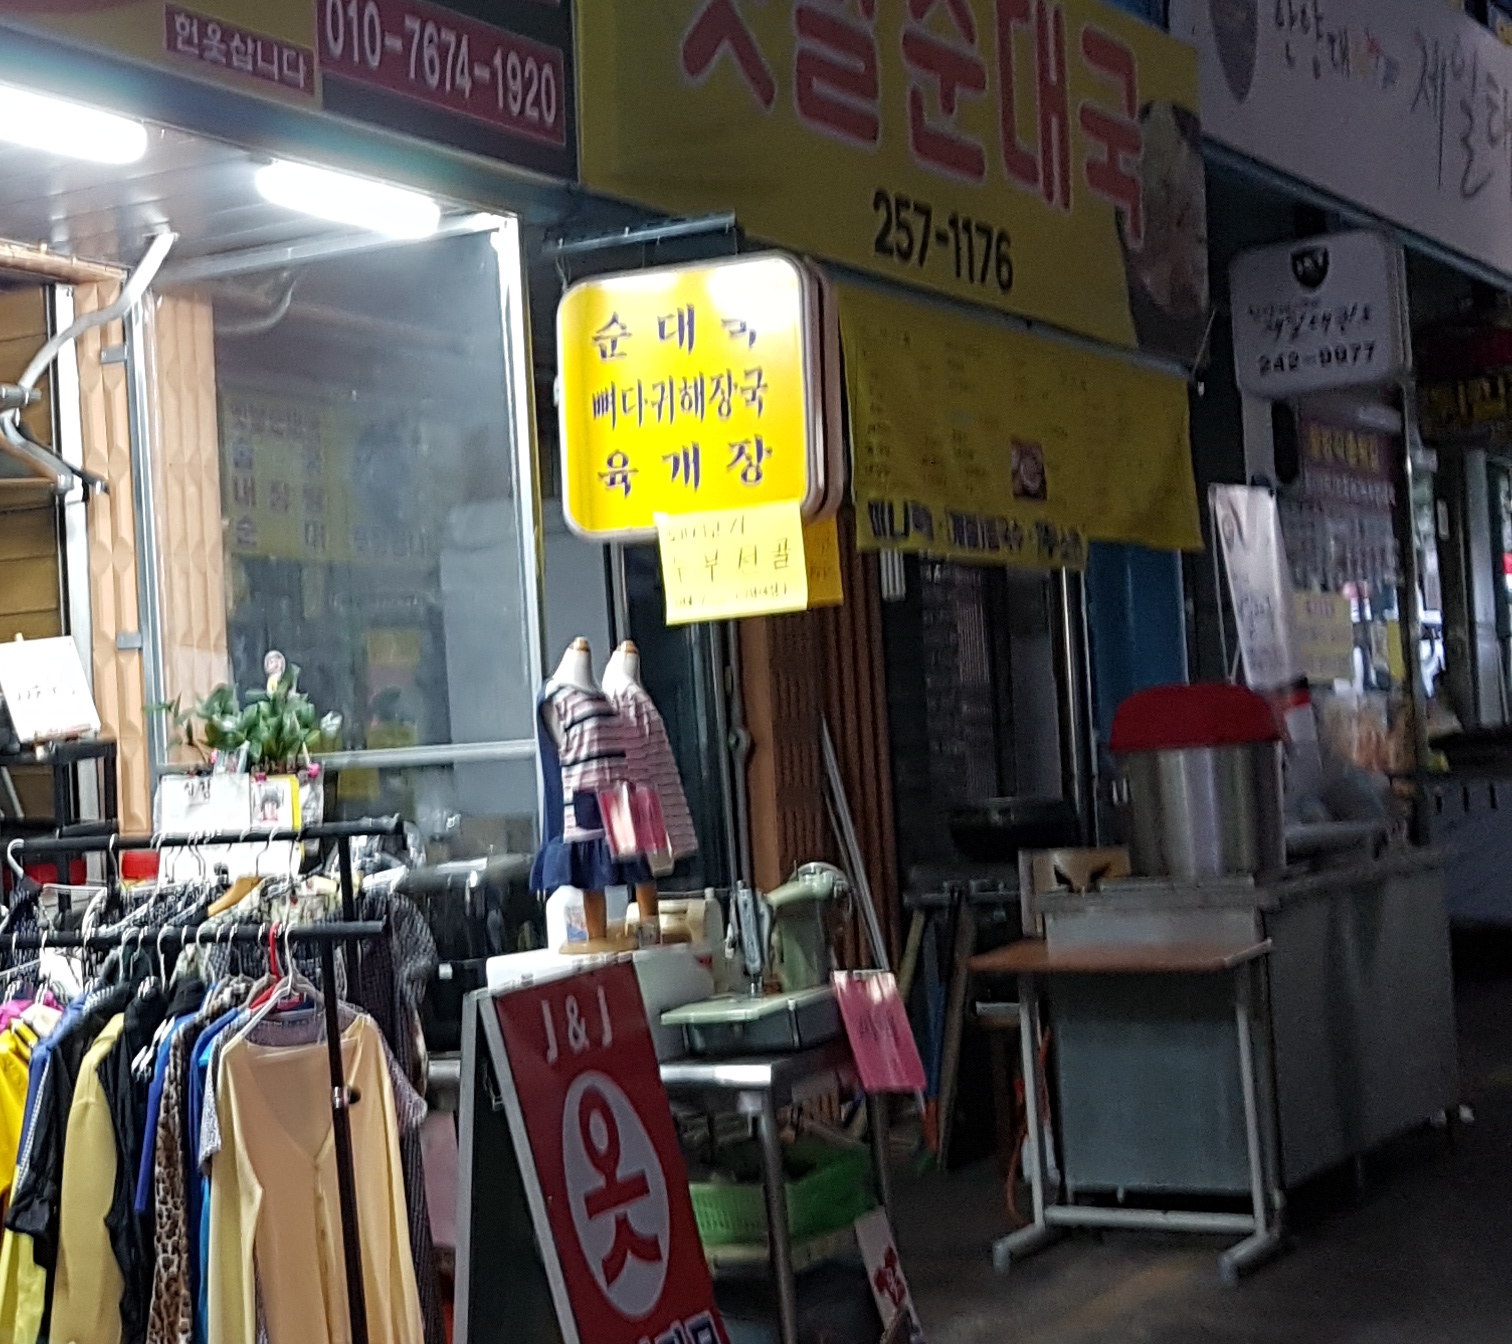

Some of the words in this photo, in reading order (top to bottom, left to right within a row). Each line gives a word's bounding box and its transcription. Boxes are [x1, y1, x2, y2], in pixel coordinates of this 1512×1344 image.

[173, 11, 307, 90] 헌옷삽니다
[872, 188, 1015, 295] 257-1176
[597, 432, 773, 499] 육개장
[577, 1084, 664, 1288] 옷
